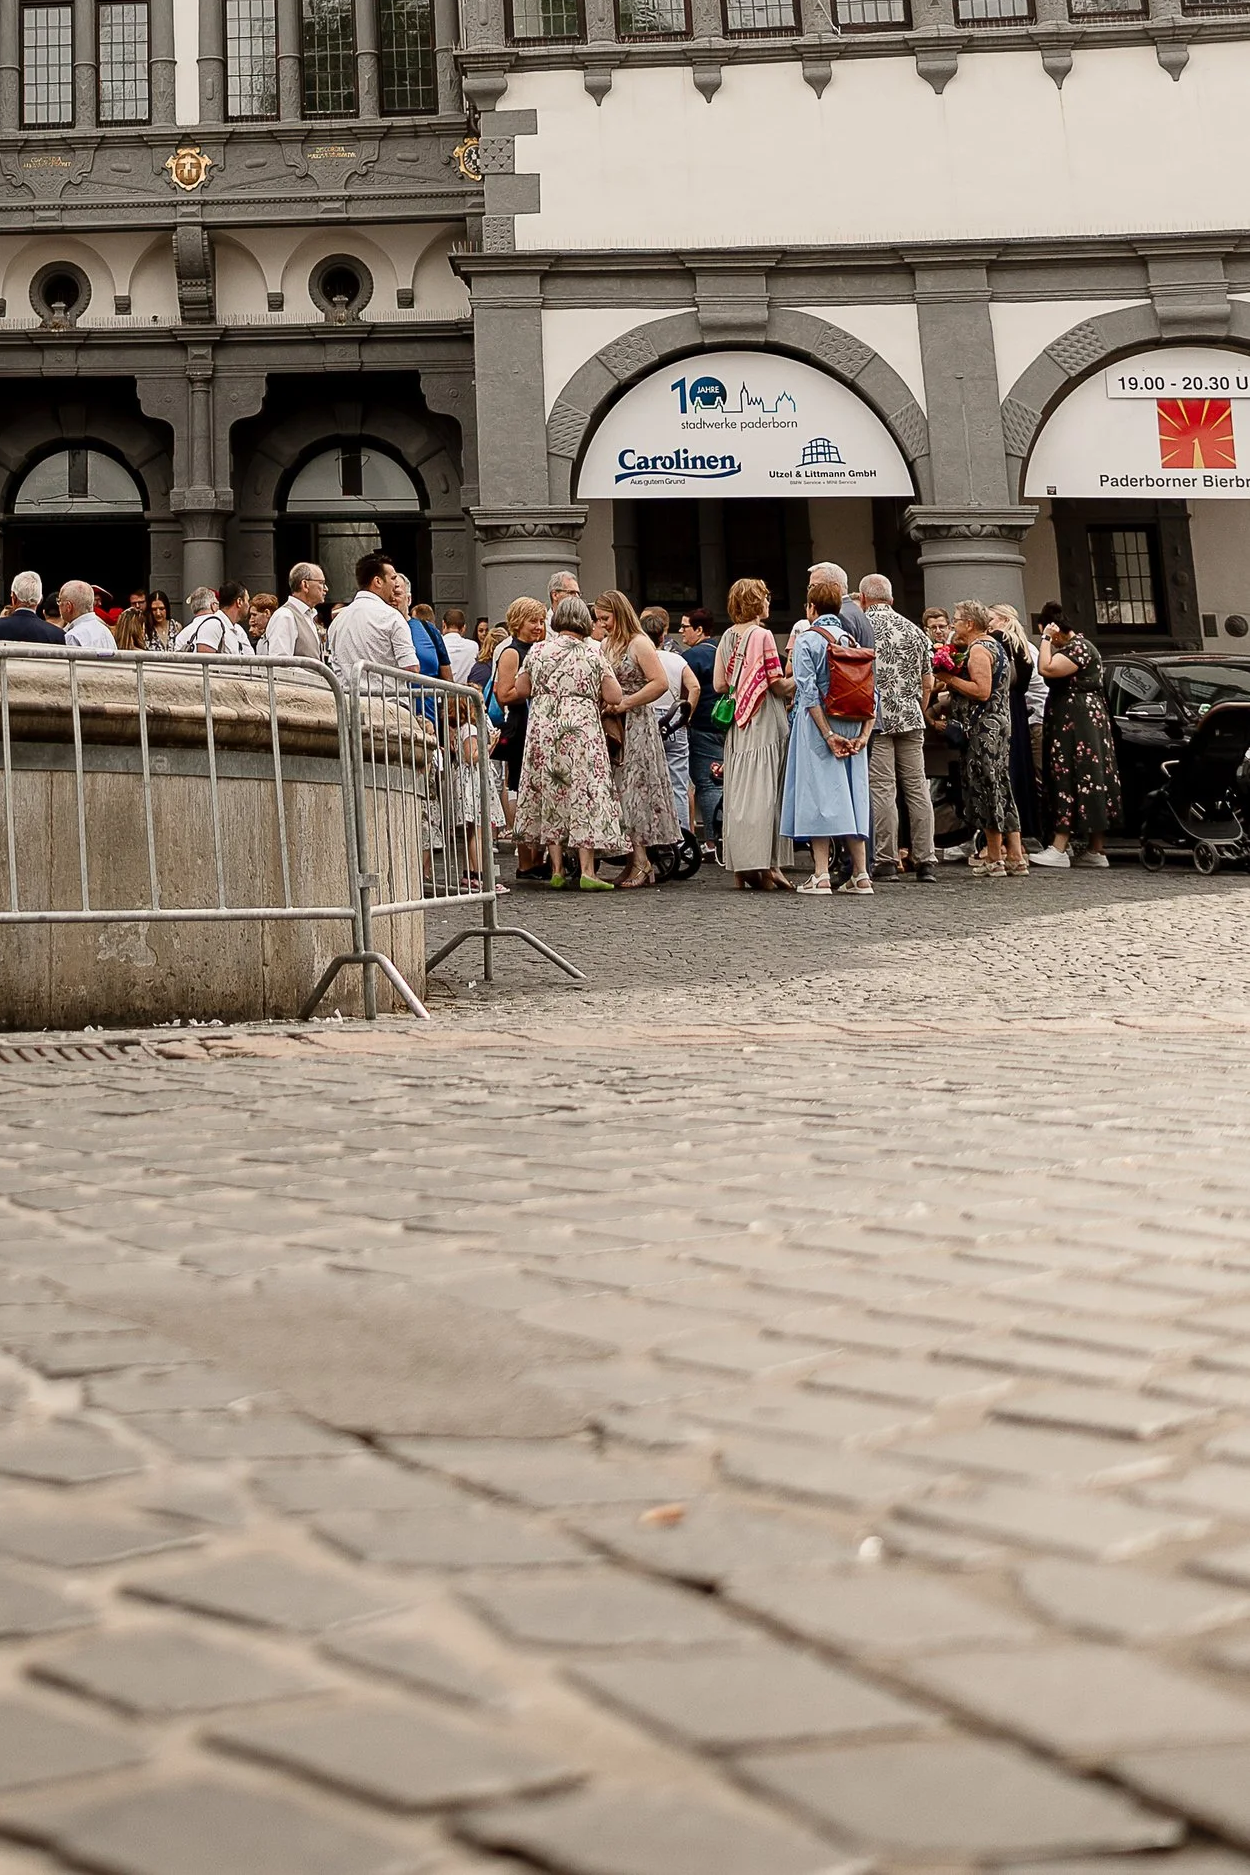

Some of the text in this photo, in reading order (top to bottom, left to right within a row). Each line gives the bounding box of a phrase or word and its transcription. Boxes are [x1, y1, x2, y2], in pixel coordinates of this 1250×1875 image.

[696, 386, 720, 394] JAHRE
[1118, 376, 1165, 390] 19.00
[1182, 376, 1230, 390] 20.30
[681, 417, 798, 431] stadtwerke paderborn
[618, 448, 737, 470] Carolinen
[805, 470, 846, 478] Littmann
[848, 470, 877, 478] GmbH
[1099, 474, 1198, 488] Paderborner
